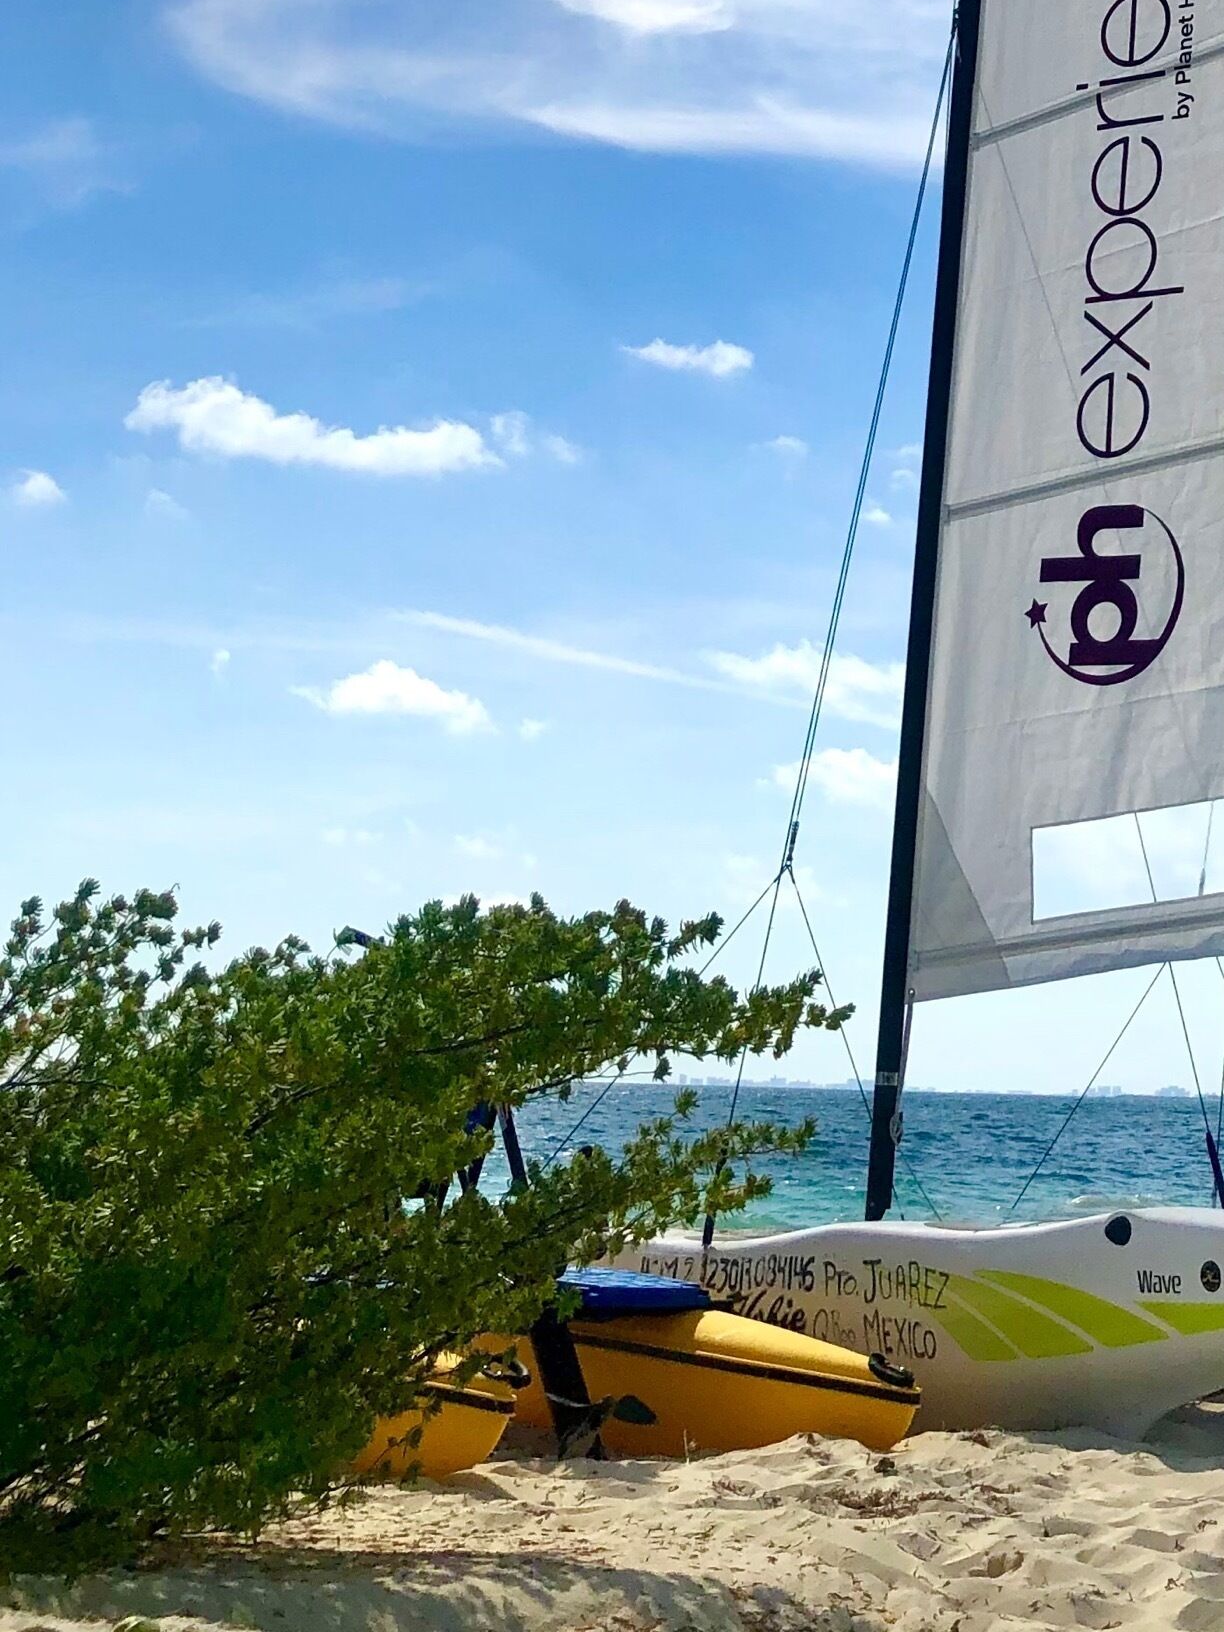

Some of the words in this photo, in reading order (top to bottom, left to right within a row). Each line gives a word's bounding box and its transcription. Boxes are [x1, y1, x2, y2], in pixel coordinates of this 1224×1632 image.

[1175, 13, 1195, 85] Planet
[1171, 91, 1194, 120] by
[863, 1258, 950, 1309] JUAREZ
[1136, 1270, 1182, 1294] Wave
[863, 1309, 937, 1359] MEXICO
